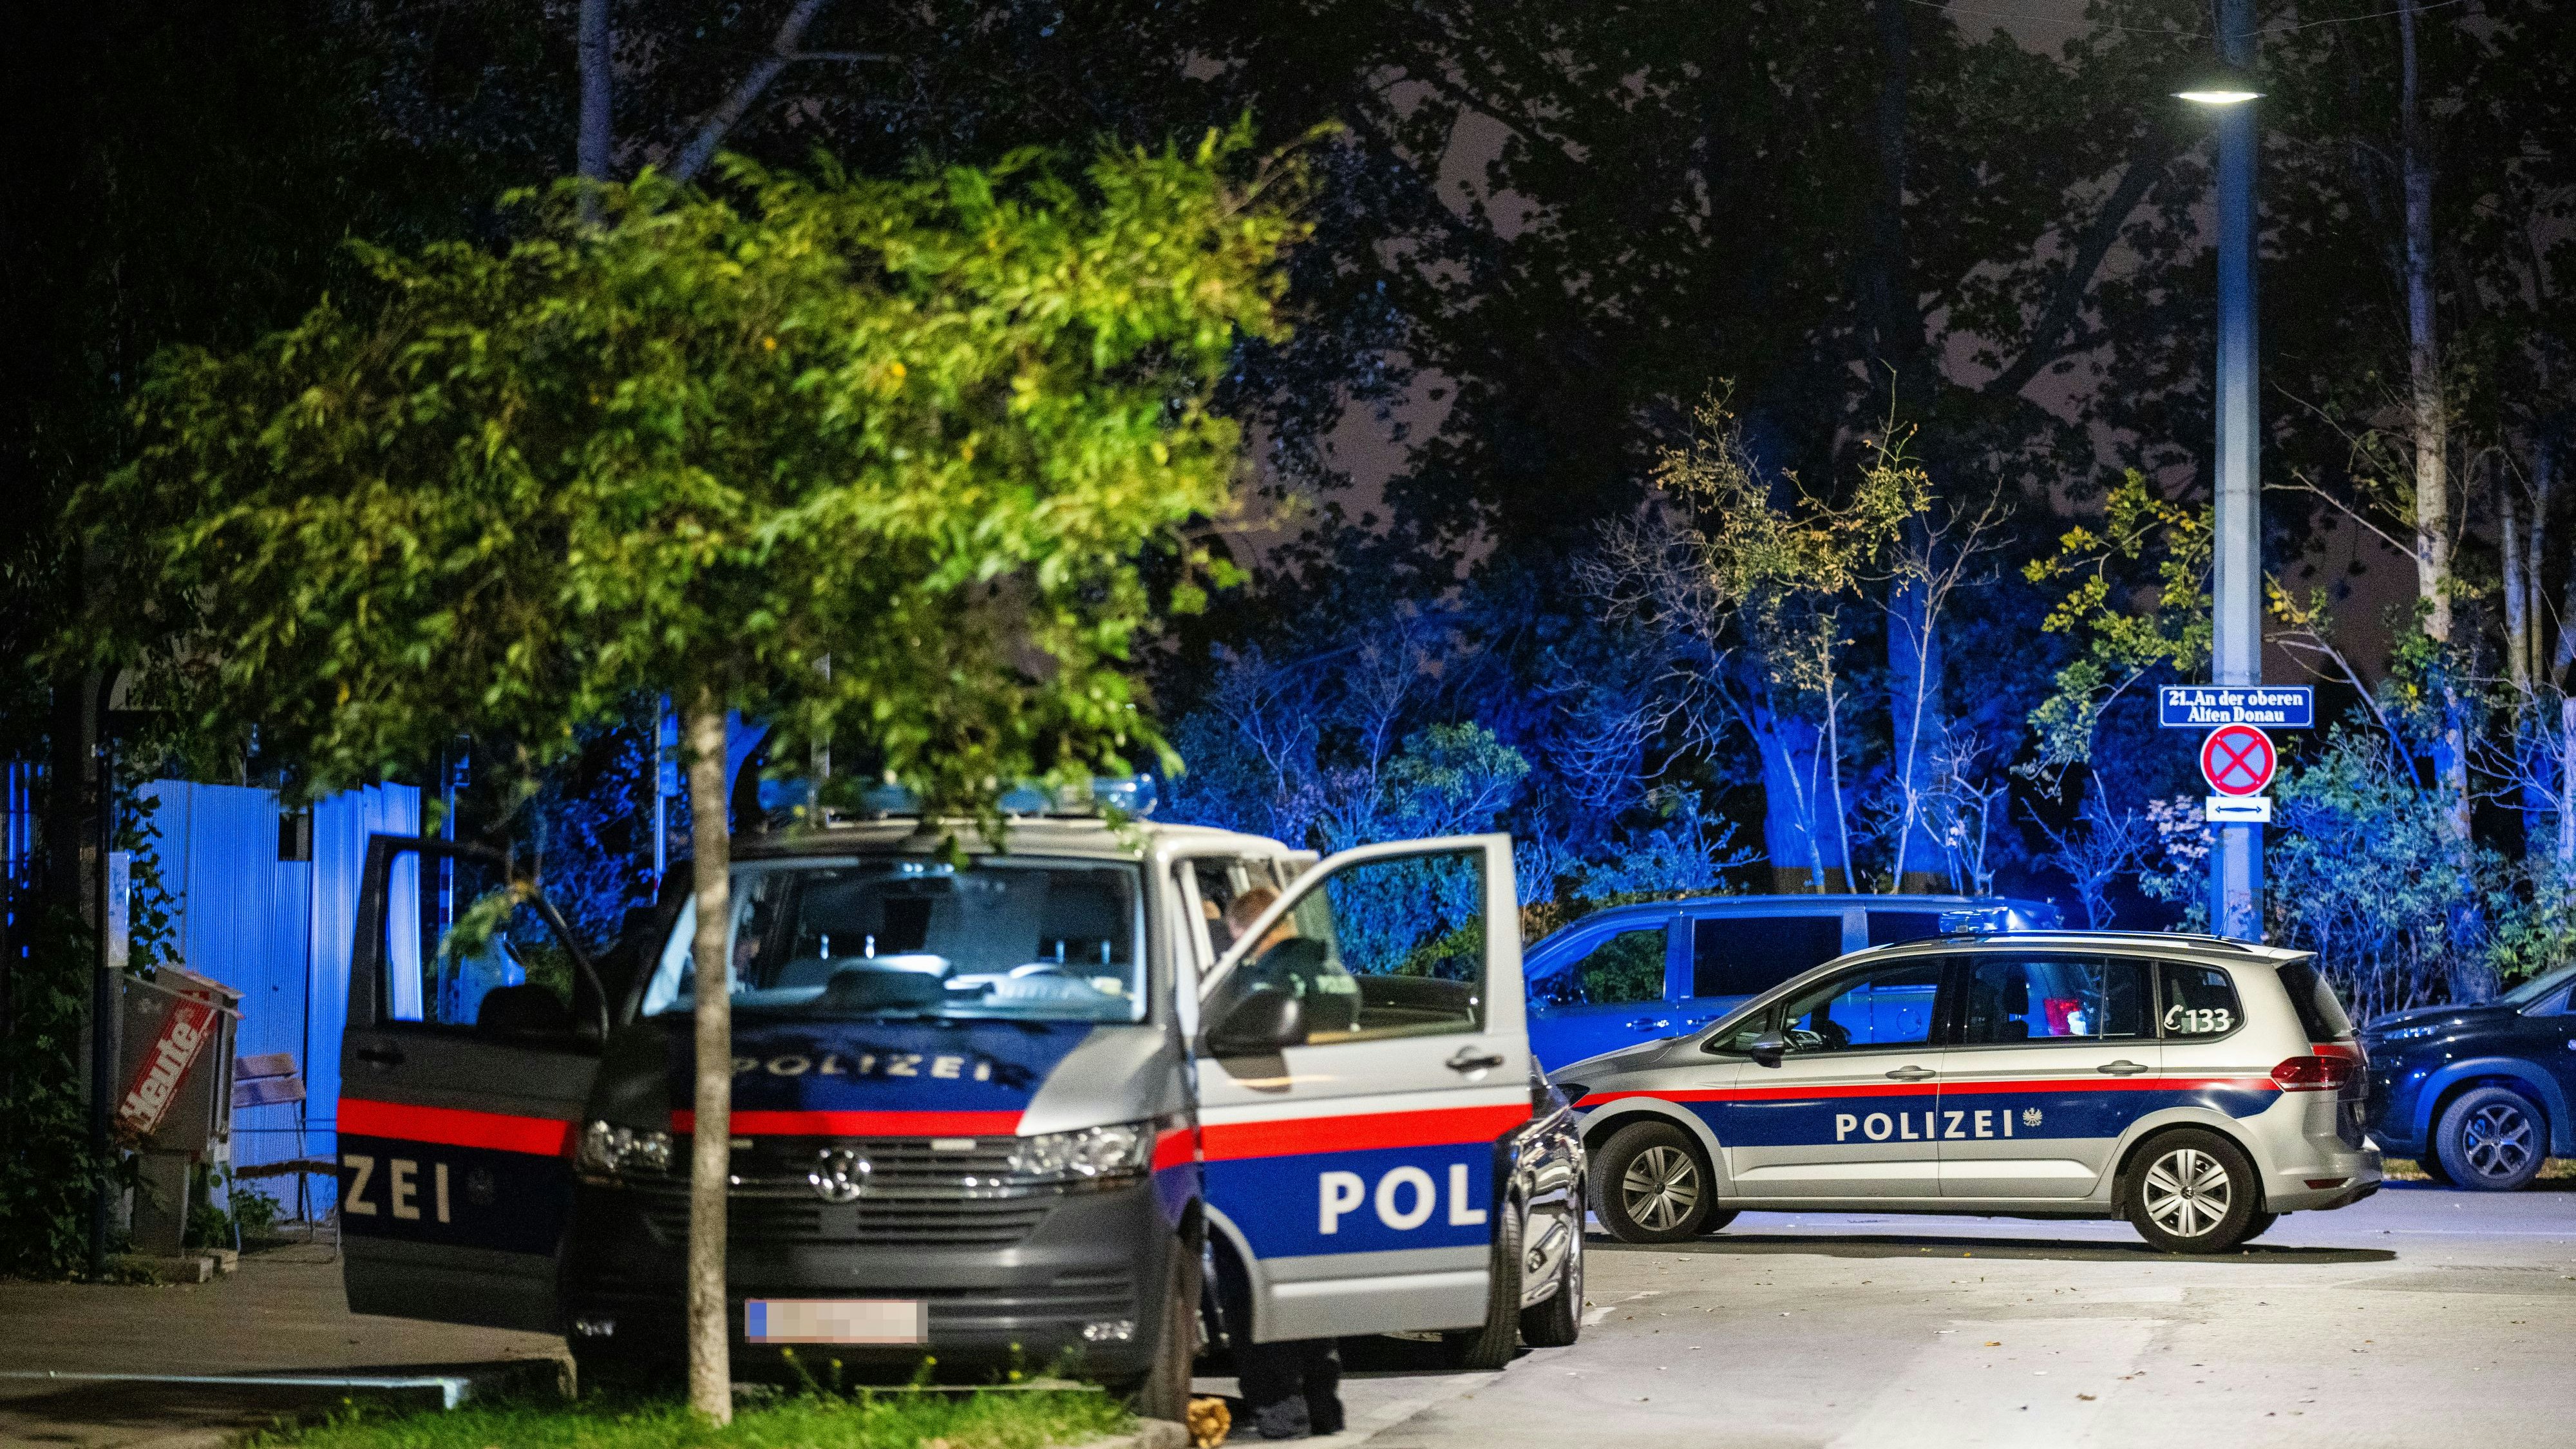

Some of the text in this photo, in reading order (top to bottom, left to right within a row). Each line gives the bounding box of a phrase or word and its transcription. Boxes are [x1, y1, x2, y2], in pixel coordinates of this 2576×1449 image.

[2194, 690, 2216, 706] An
[2219, 690, 2244, 706] der
[2248, 690, 2303, 706] oberen
[2187, 706, 2285, 722] Alten Donau
[2185, 1009, 2230, 1033] 133
[120, 1022, 198, 1131] Heute
[730, 1054, 991, 1081] POLIZEI
[1835, 1110, 2013, 1141] POLIZEI
[343, 1154, 450, 1223] ZEI
[1319, 1163, 1488, 1234] POL
